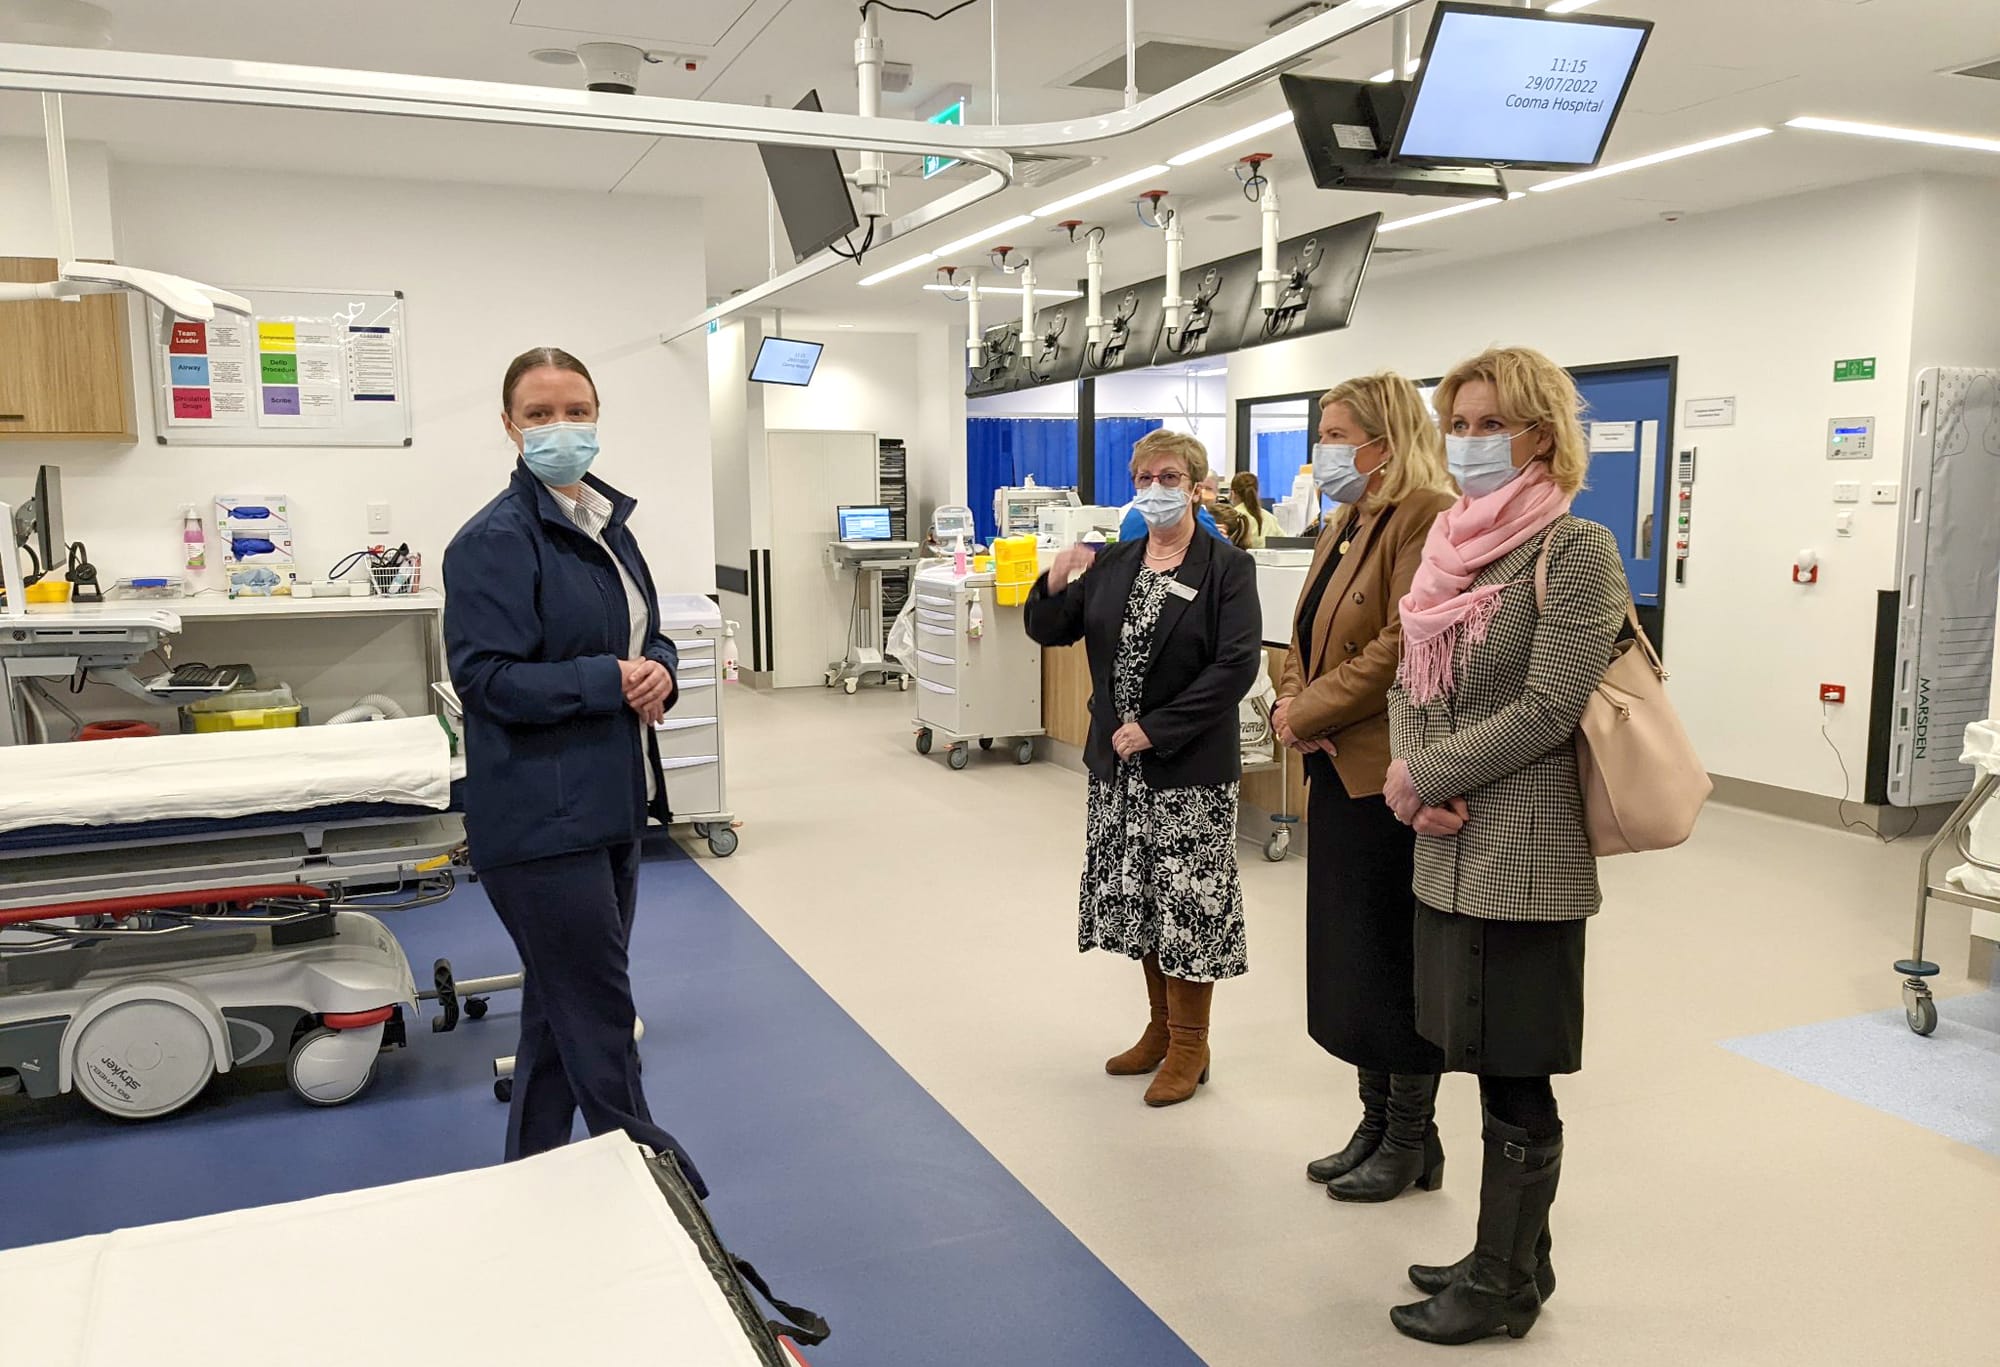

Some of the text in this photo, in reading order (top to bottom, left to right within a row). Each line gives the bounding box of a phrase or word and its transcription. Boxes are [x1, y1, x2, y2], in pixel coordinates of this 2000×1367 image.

[1550, 58, 1588, 73] 11:15
[1525, 75, 1598, 94] 29/07/2022
[1505, 94, 1604, 114] Cooma Hospital
[1915, 677, 1931, 759] MARSDEN
[101, 1057, 141, 1090] stryker
